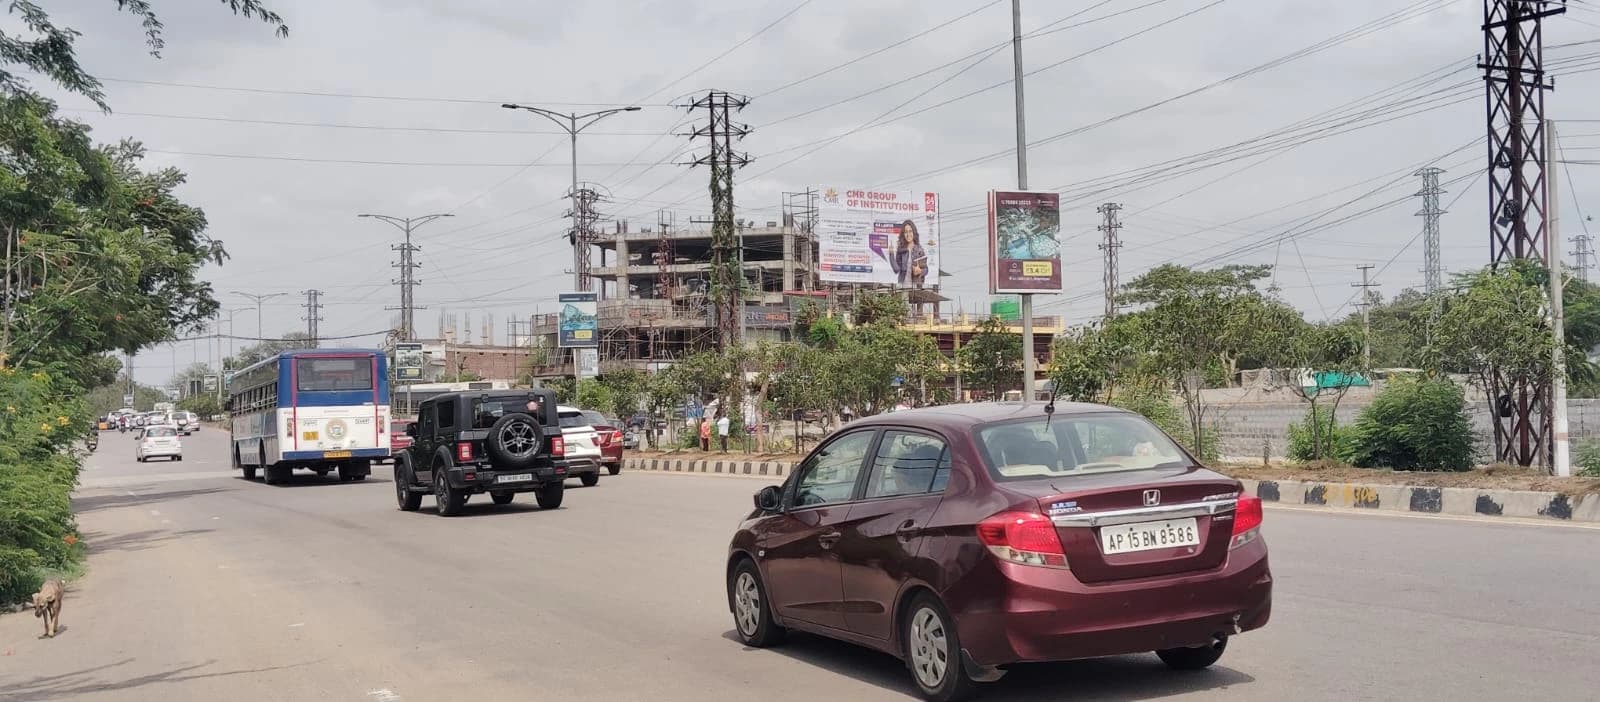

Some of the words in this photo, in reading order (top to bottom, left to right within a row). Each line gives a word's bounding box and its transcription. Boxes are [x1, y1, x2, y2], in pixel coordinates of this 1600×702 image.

[846, 190, 865, 199] CMR
[867, 191, 897, 200] GROUP
[847, 199, 859, 207] OF
[860, 200, 920, 211] INSTITUTIONS
[1109, 535, 1124, 550] AP
[1128, 532, 1139, 549] 15
[1144, 530, 1158, 546] BN
[1160, 526, 1193, 544] 8586
